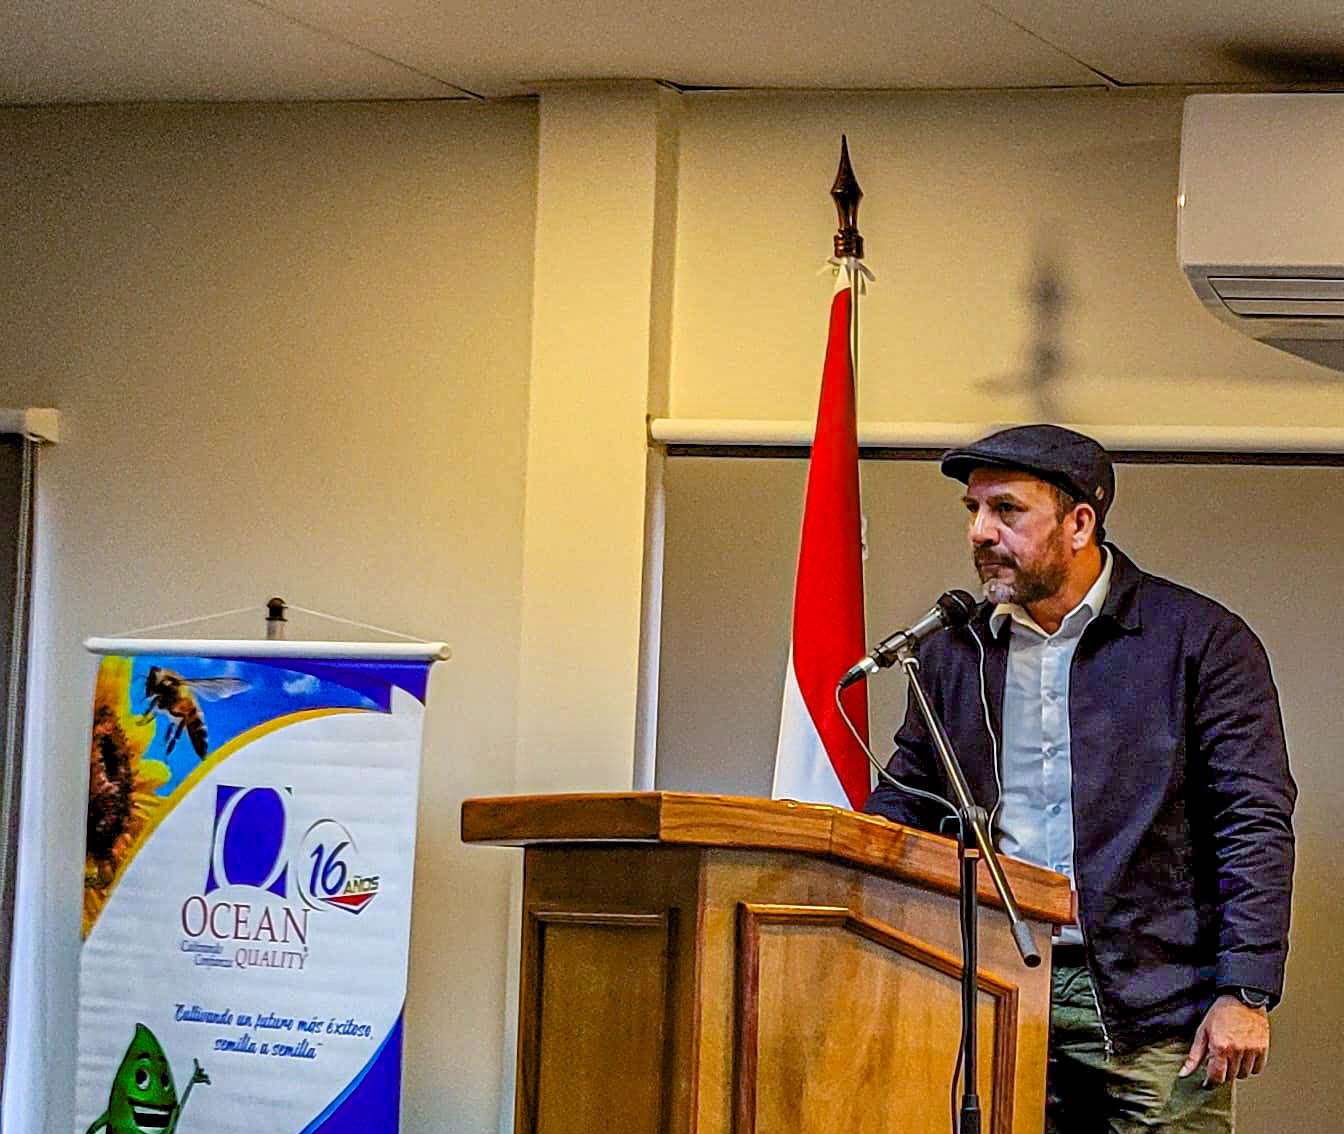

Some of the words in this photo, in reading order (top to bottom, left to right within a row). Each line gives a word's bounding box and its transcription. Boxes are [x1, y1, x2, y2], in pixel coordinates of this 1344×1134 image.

[310, 841, 350, 897] 16
[181, 896, 310, 944] OCEAN
[235, 948, 308, 969] QUALITY
